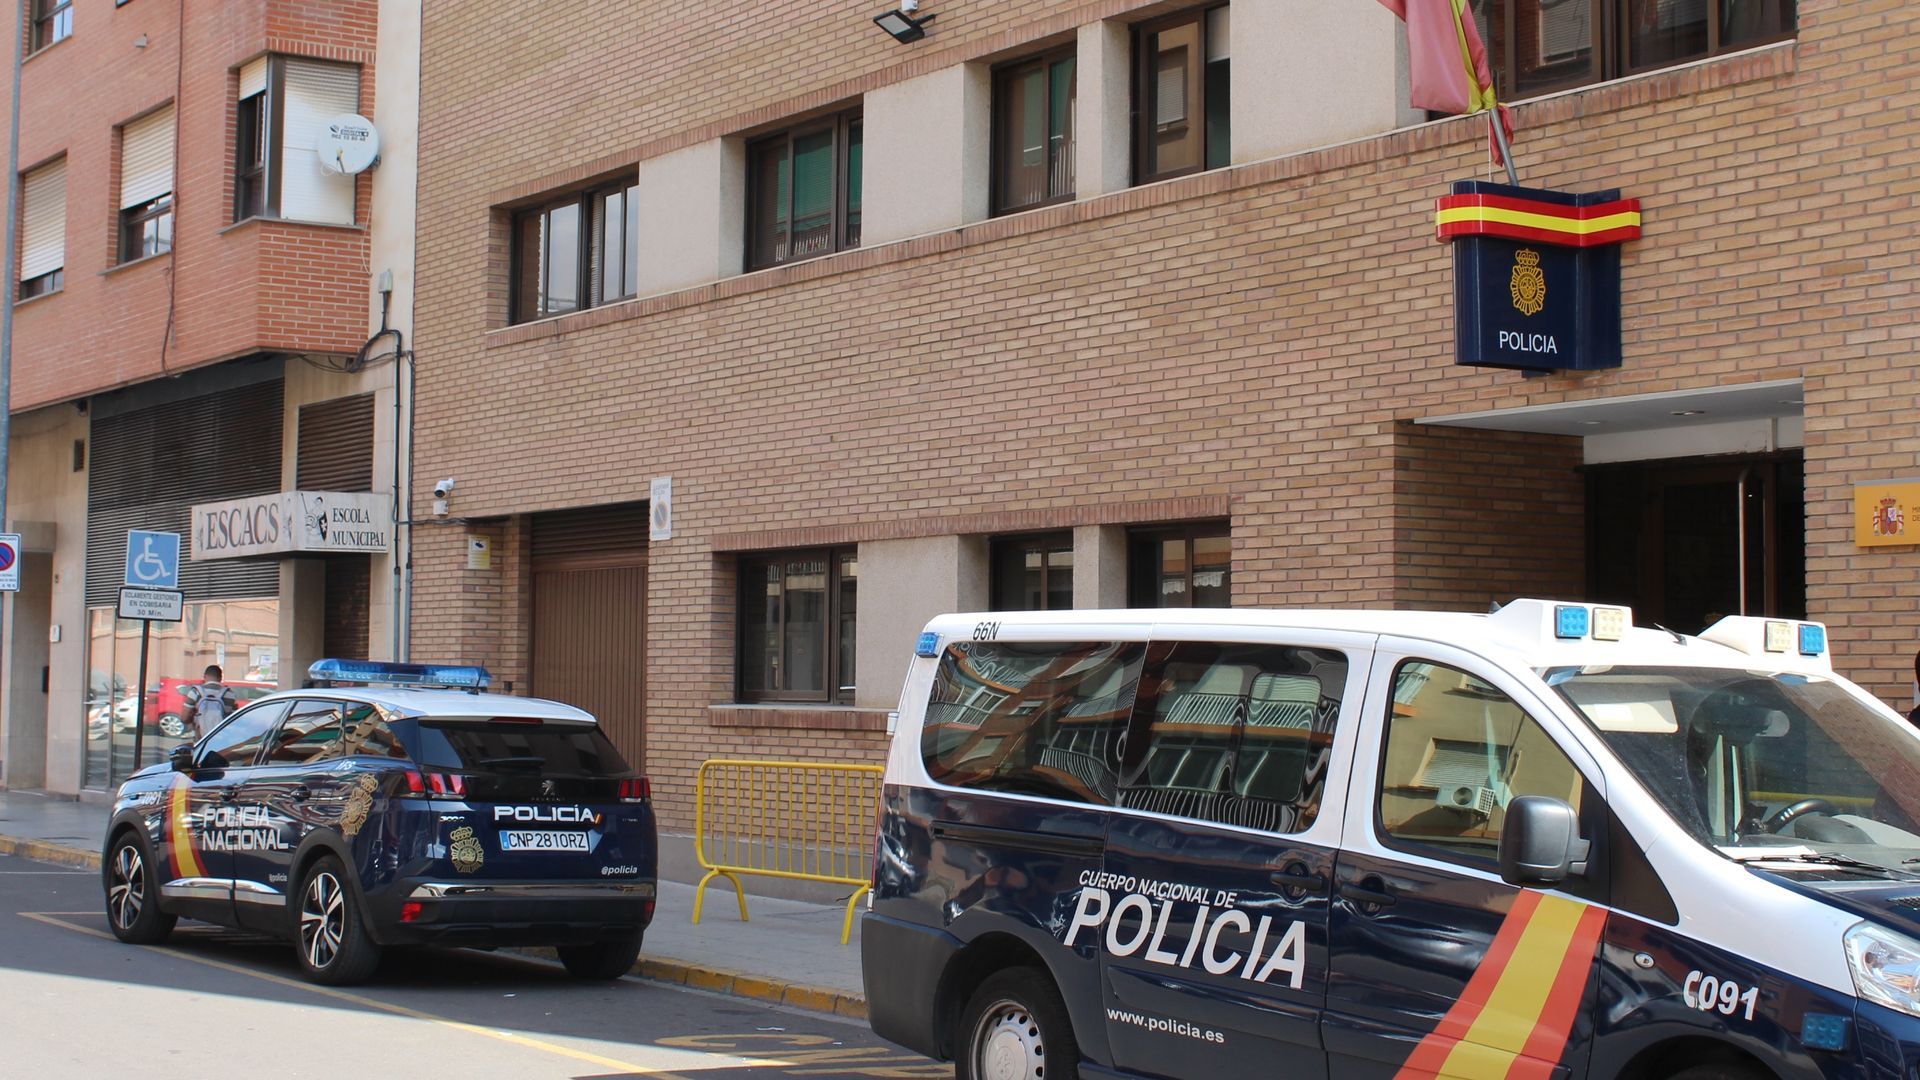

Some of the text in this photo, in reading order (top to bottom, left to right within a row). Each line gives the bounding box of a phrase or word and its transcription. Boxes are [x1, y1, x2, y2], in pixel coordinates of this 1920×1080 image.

[1499, 330, 1558, 354] POLICIA
[332, 507, 370, 523] ESCOLA
[206, 502, 280, 550] ESCACS
[332, 531, 387, 546] MUNICIPAL
[973, 621, 1001, 641] 66N
[494, 804, 595, 822] POLICÍA
[203, 829, 289, 850] NACIONAL
[601, 865, 638, 876] @policia
[1078, 869, 1238, 910] CUERPO NACIONAL DE
[1063, 886, 1306, 990] POLICIA
[1106, 1007, 1225, 1044] www.policia.es
